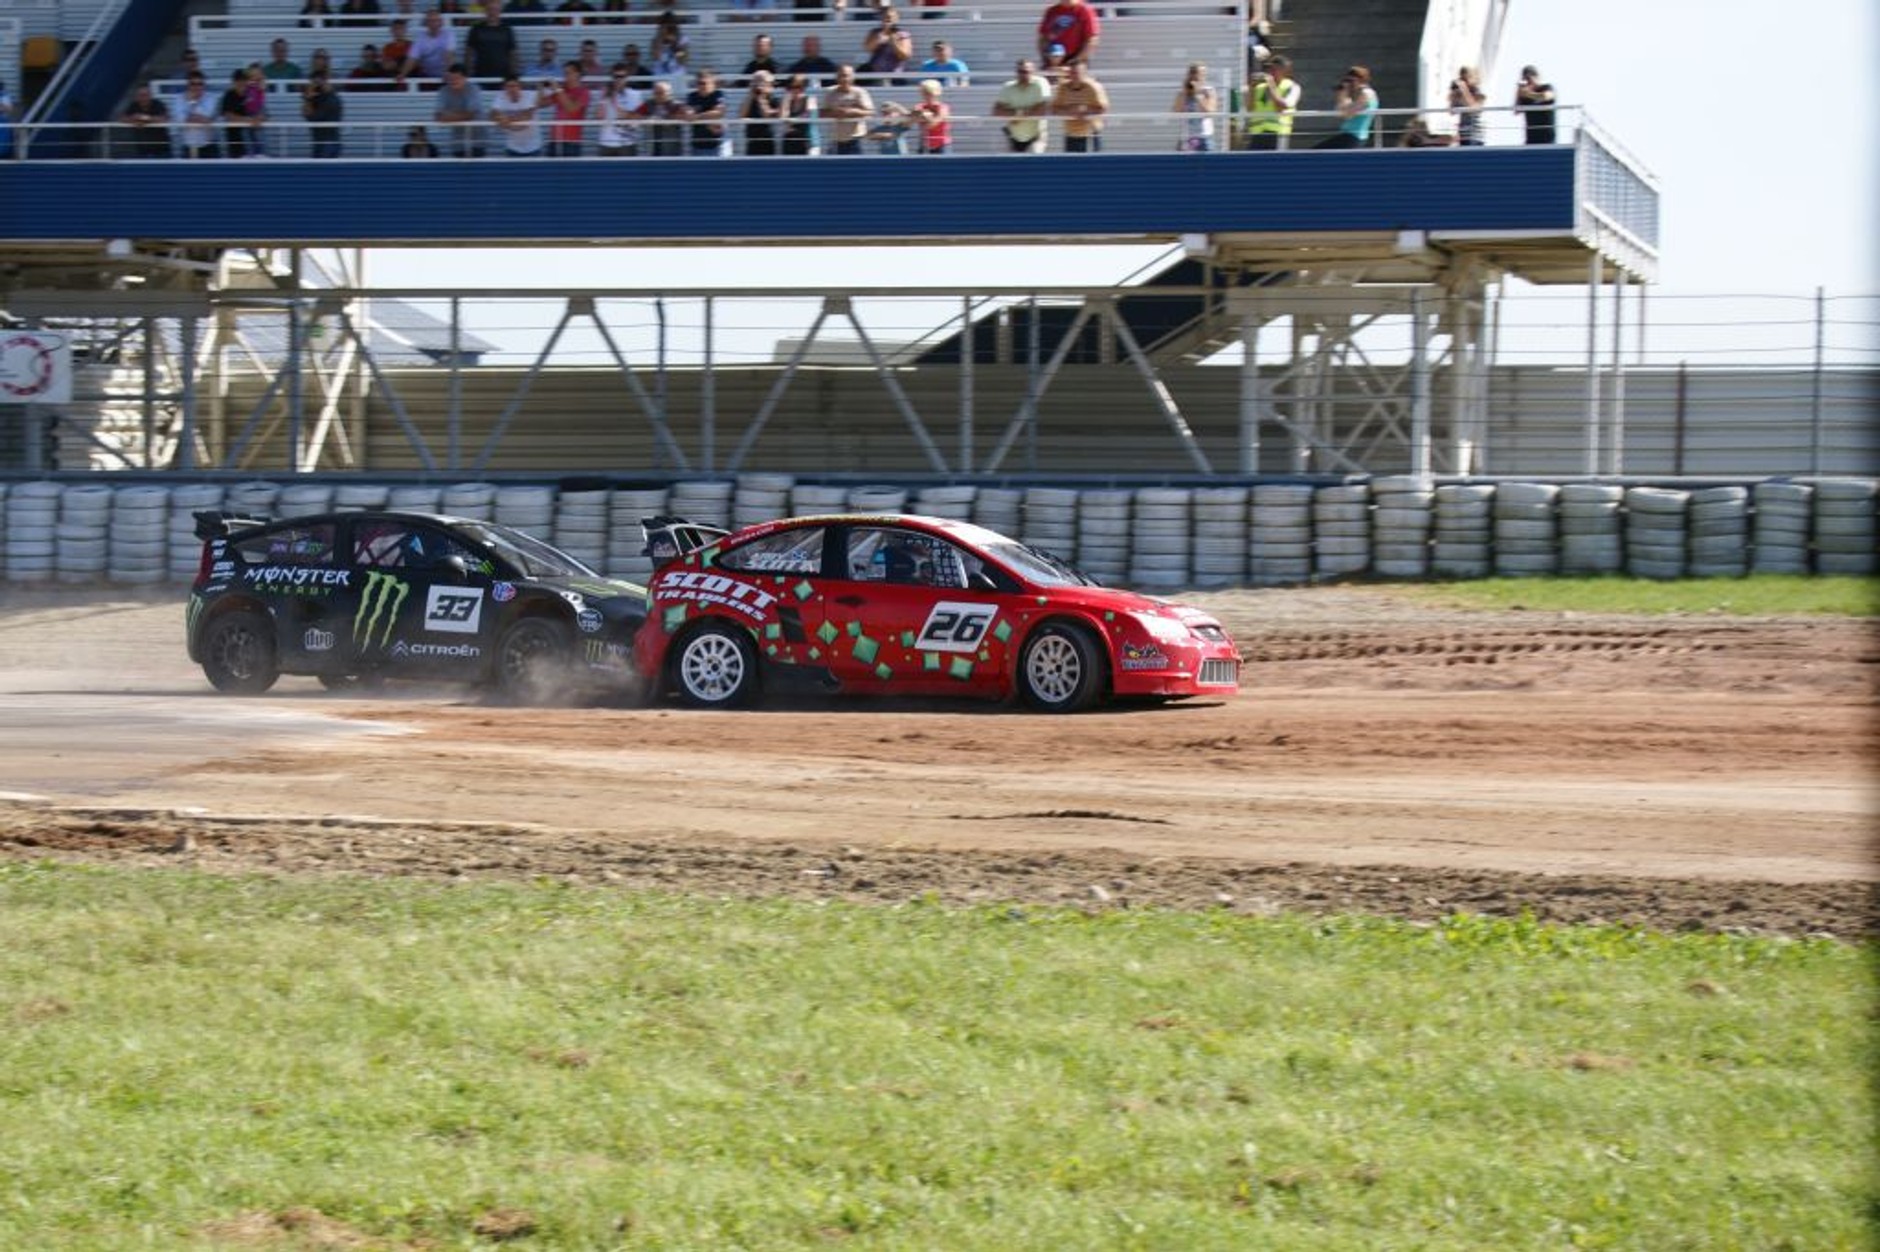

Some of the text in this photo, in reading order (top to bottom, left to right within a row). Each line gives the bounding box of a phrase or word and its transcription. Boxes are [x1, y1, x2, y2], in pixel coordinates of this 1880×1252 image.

[660, 572, 778, 609] SCOTT
[428, 594, 480, 622] 33
[923, 612, 989, 642] 26
